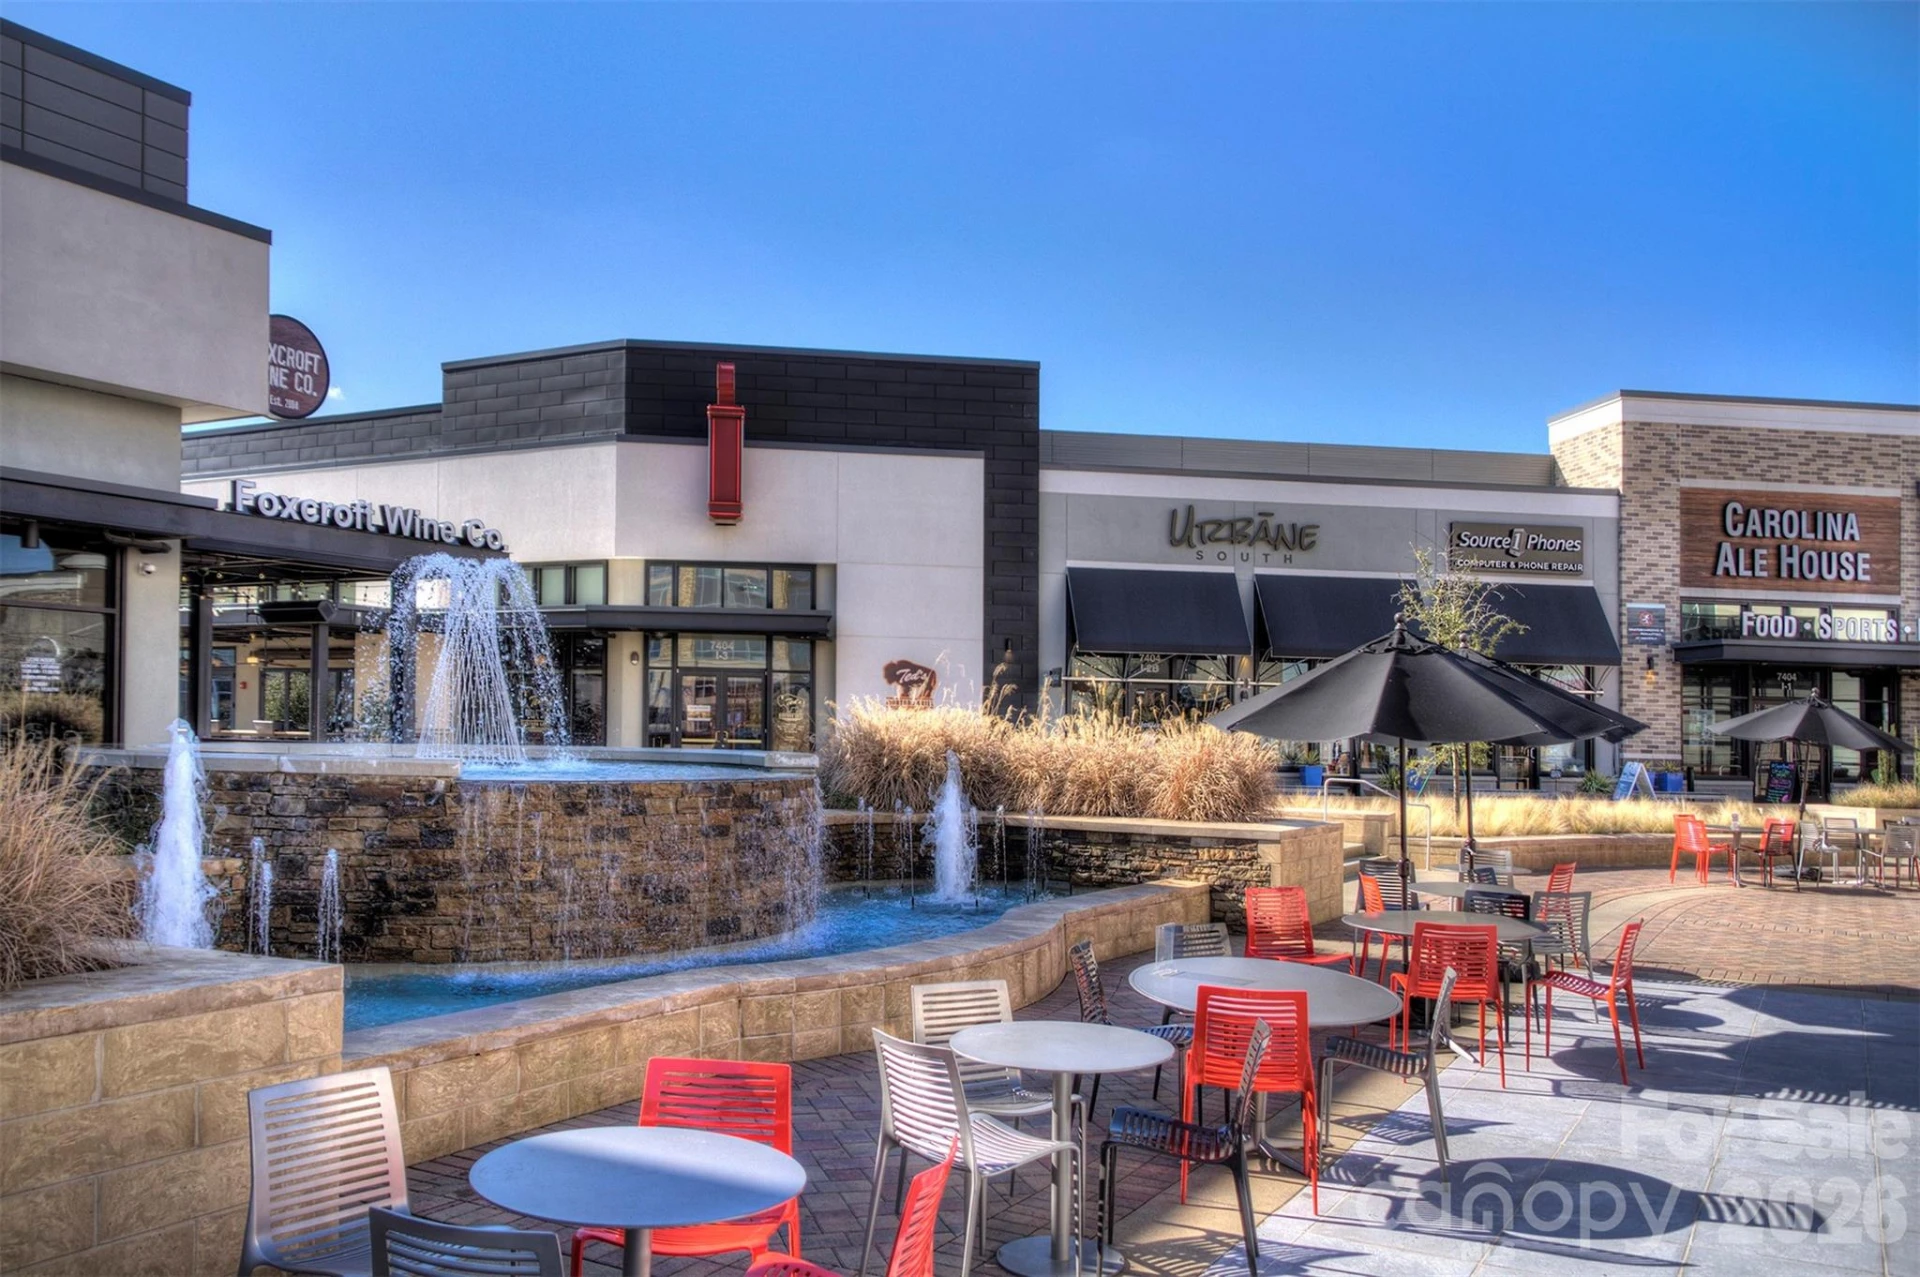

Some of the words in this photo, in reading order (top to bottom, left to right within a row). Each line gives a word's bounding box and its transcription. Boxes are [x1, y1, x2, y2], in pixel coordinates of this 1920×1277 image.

[294, 372, 318, 397] CO.
[231, 480, 377, 533] Foxcroft
[380, 504, 456, 543] Wine
[463, 518, 510, 551] Co.
[1725, 502, 1860, 541] CAROLINA
[1459, 531, 1511, 549] Source
[1527, 534, 1581, 551] Phones
[1196, 551, 1293, 564] SOUTH
[1457, 559, 1507, 568] COMPUTER
[1519, 561, 1549, 570] PHONE
[1552, 562, 1583, 571] REPAIR
[1715, 542, 1768, 577] ALE
[1780, 544, 1871, 581] HOUSE
[1741, 611, 1797, 638] FOOD
[1818, 614, 1898, 642] SPORTS
[710, 641, 735, 650] 7404
[896, 668, 927, 683] Ted's
[1777, 672, 1797, 681] 7404
